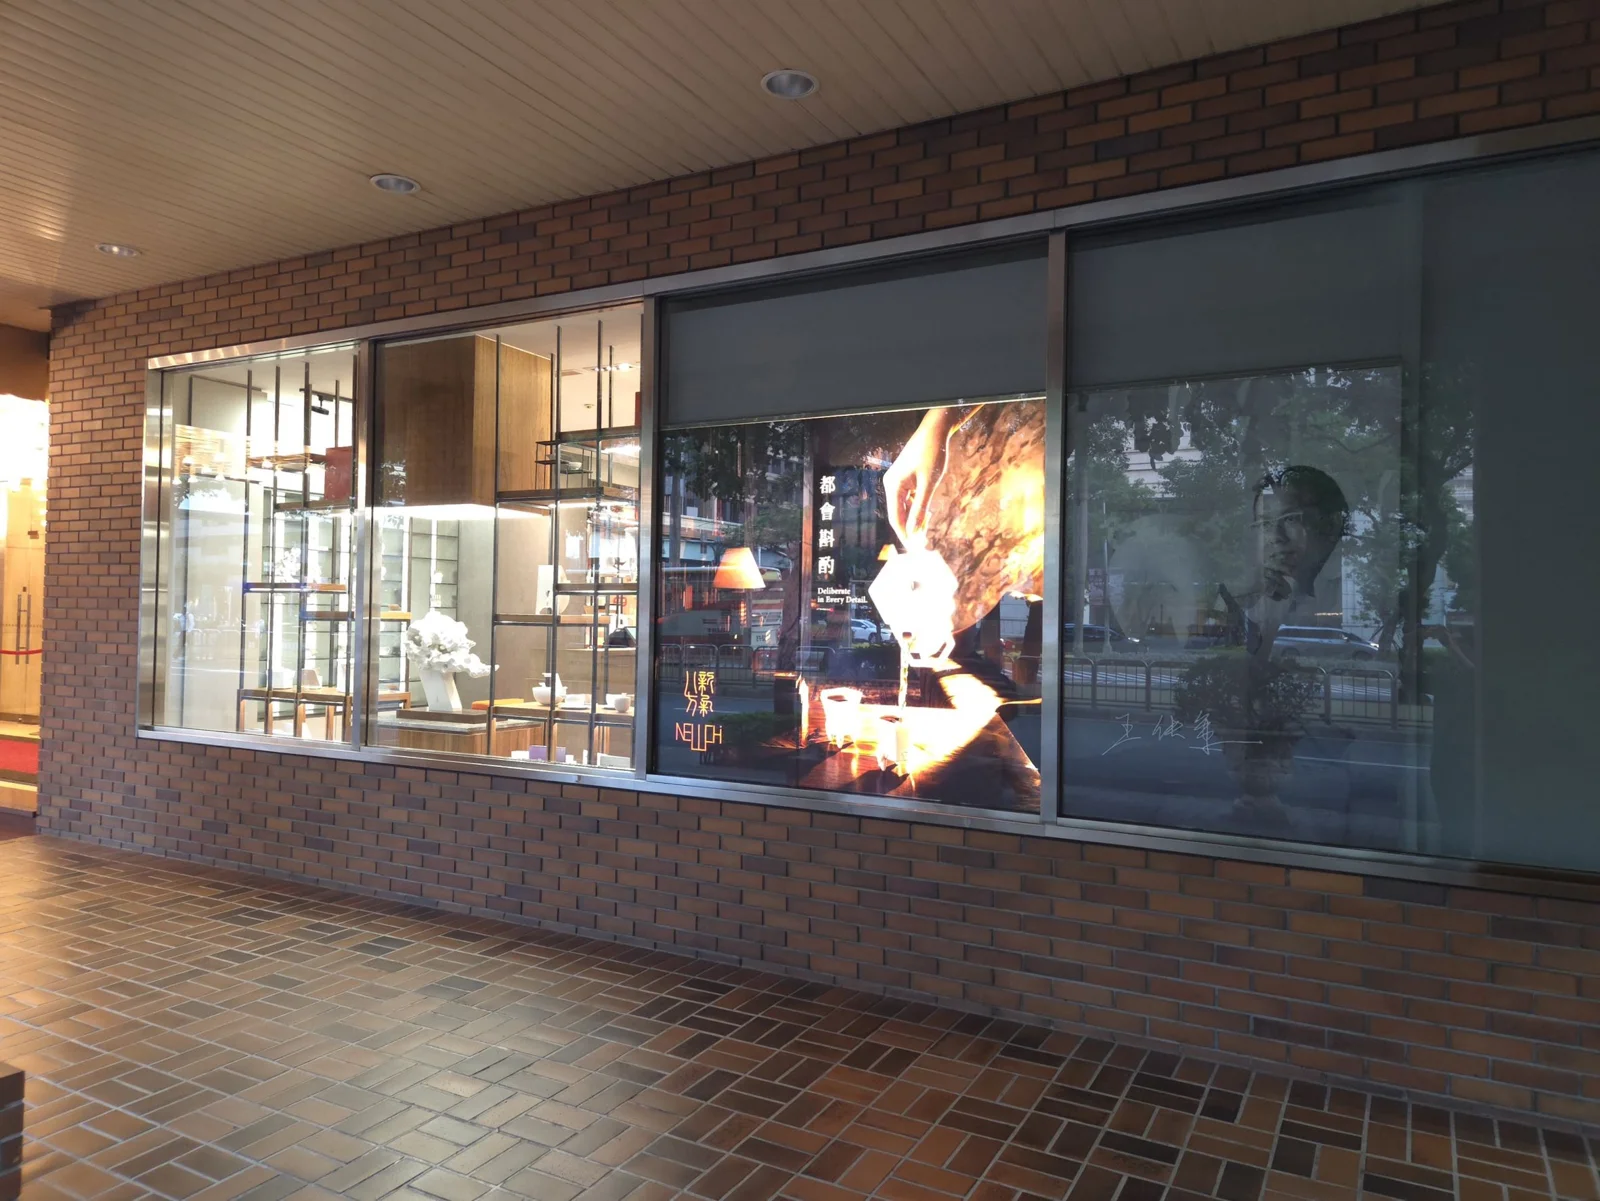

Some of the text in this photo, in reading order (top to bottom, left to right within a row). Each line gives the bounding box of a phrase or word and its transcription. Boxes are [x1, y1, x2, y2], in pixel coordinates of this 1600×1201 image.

[818, 475, 836, 575] 都會斟酌
[817, 587, 851, 595] Deliberate
[825, 596, 845, 605] Every
[845, 596, 868, 604] Detail.
